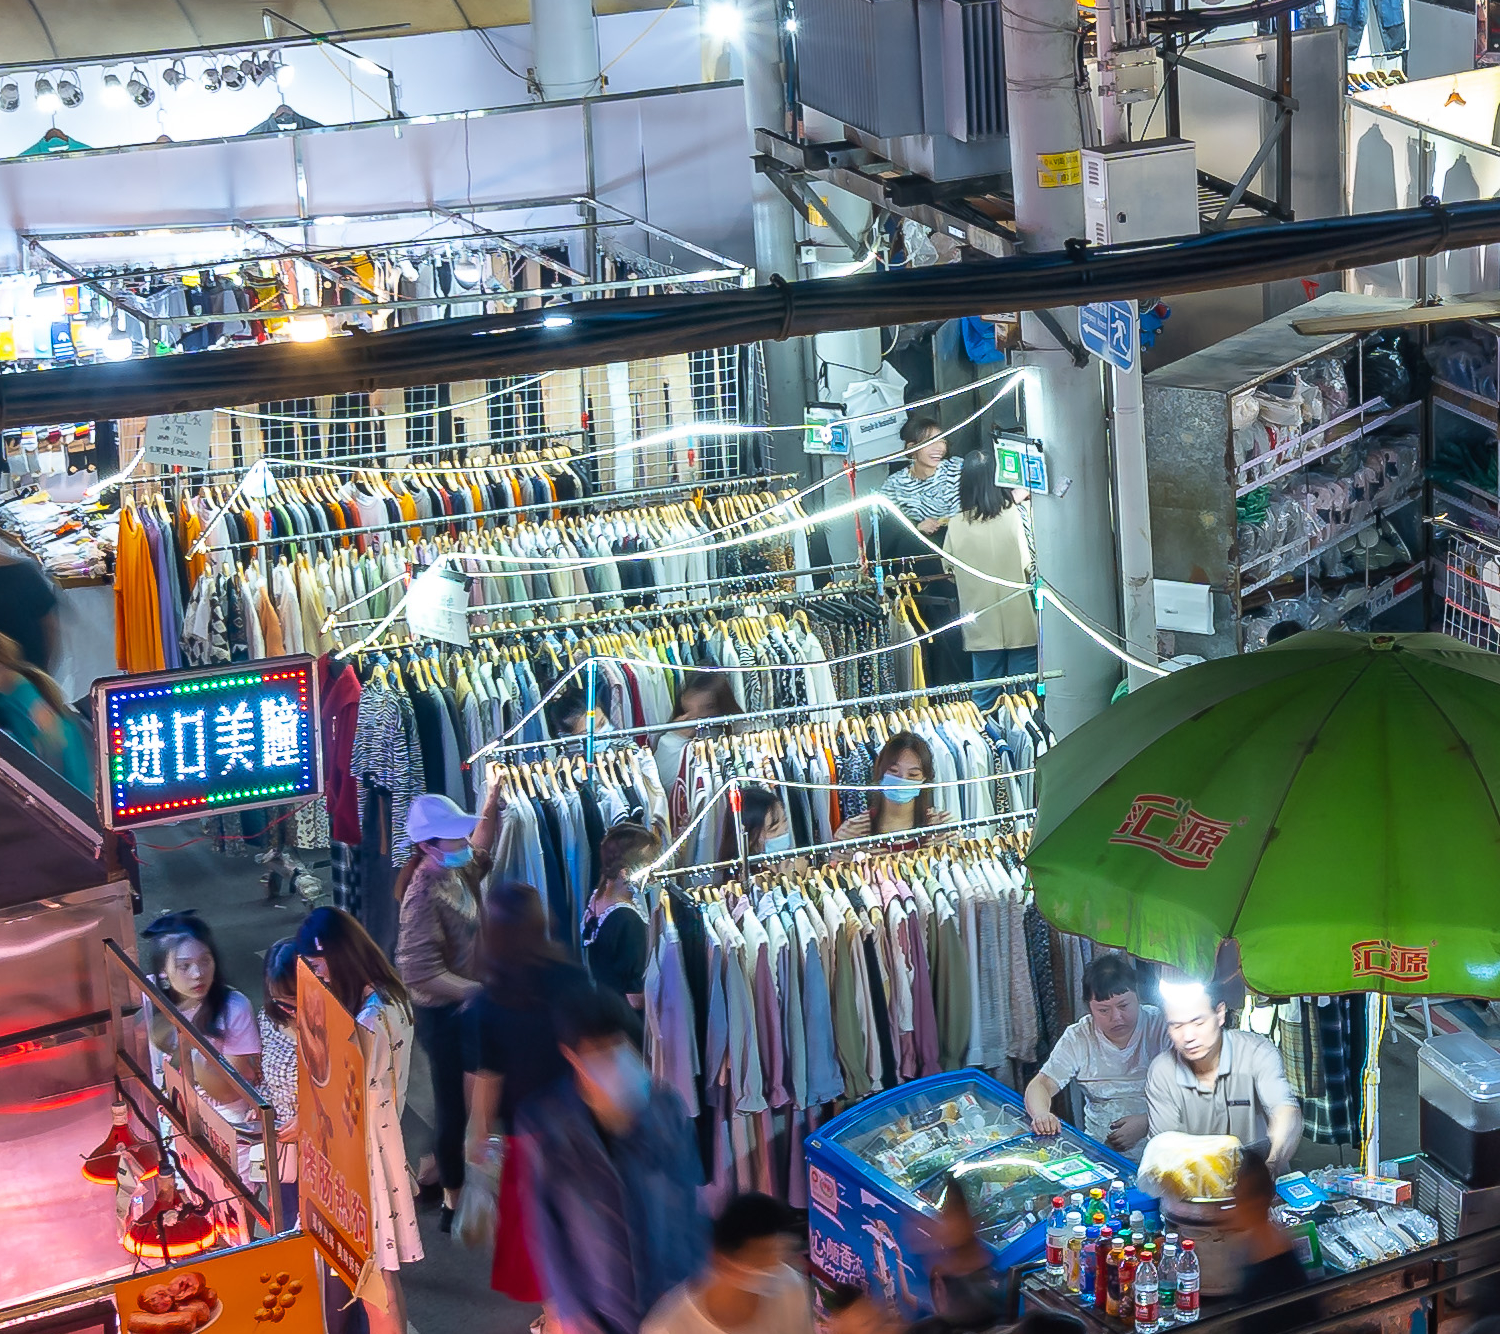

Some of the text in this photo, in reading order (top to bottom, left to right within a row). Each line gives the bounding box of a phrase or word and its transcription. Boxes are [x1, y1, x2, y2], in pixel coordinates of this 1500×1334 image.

[121, 694, 303, 787] 进口美瞳
[1112, 793, 1233, 869] 汇源
[1350, 939, 1430, 984] 汇源
